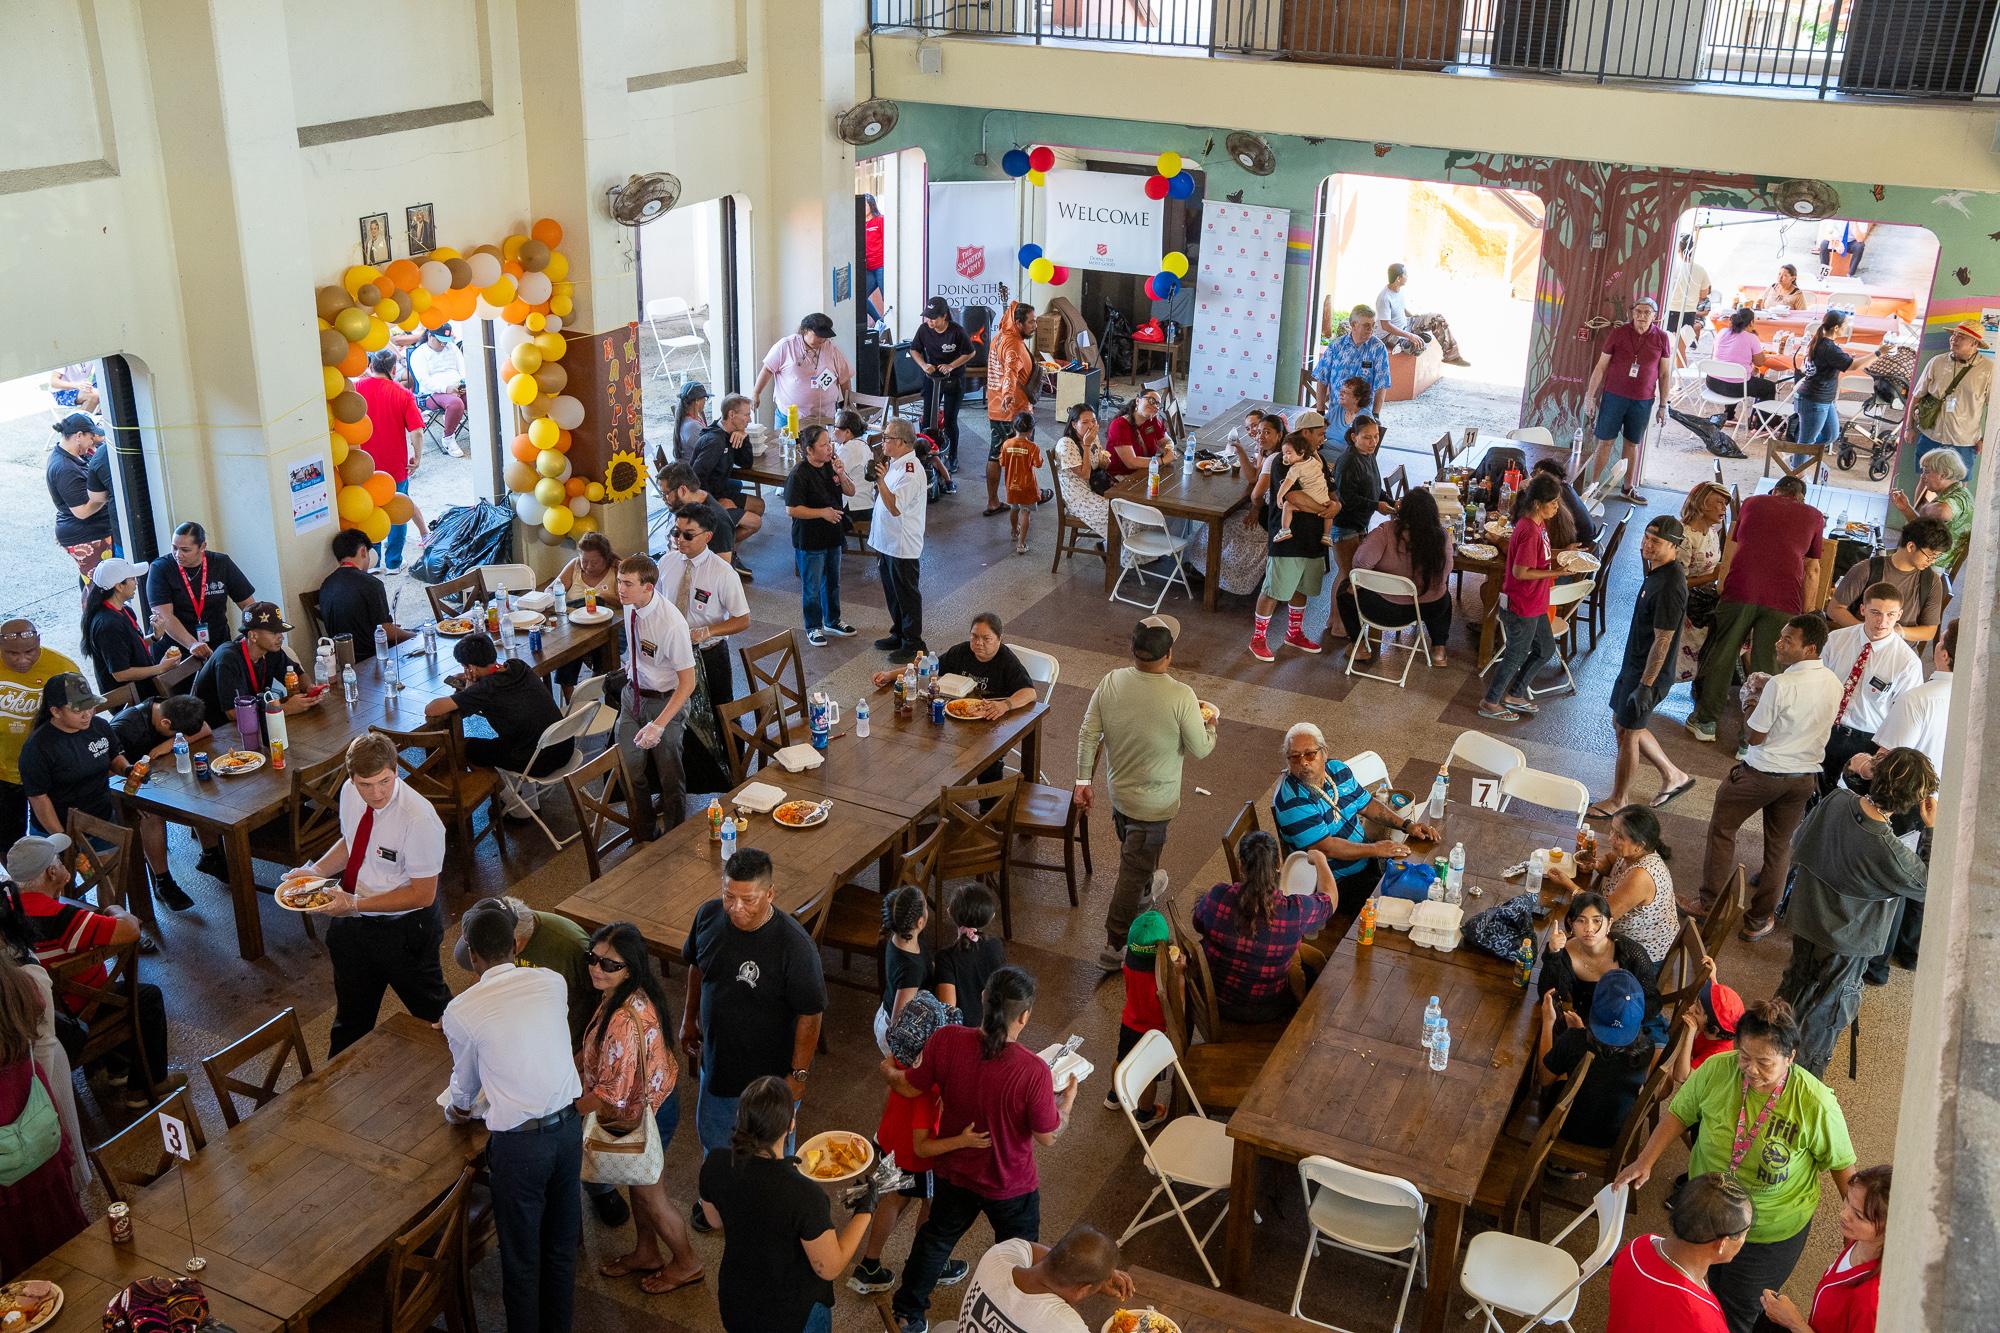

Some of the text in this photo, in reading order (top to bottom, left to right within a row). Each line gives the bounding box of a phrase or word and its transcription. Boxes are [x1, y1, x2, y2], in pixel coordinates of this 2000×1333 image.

[1058, 201, 1150, 227] WELCOME
[957, 249, 983, 272] SALVATION
[966, 259, 982, 275] ARMY
[1820, 267, 1830, 277] 15
[937, 283, 1004, 296] DOING TH
[820, 373, 833, 387] 13
[1466, 431, 1476, 444] 11
[1478, 783, 1491, 802] 7
[166, 1122, 183, 1152] 3
[1757, 1163, 1789, 1185] RUN
